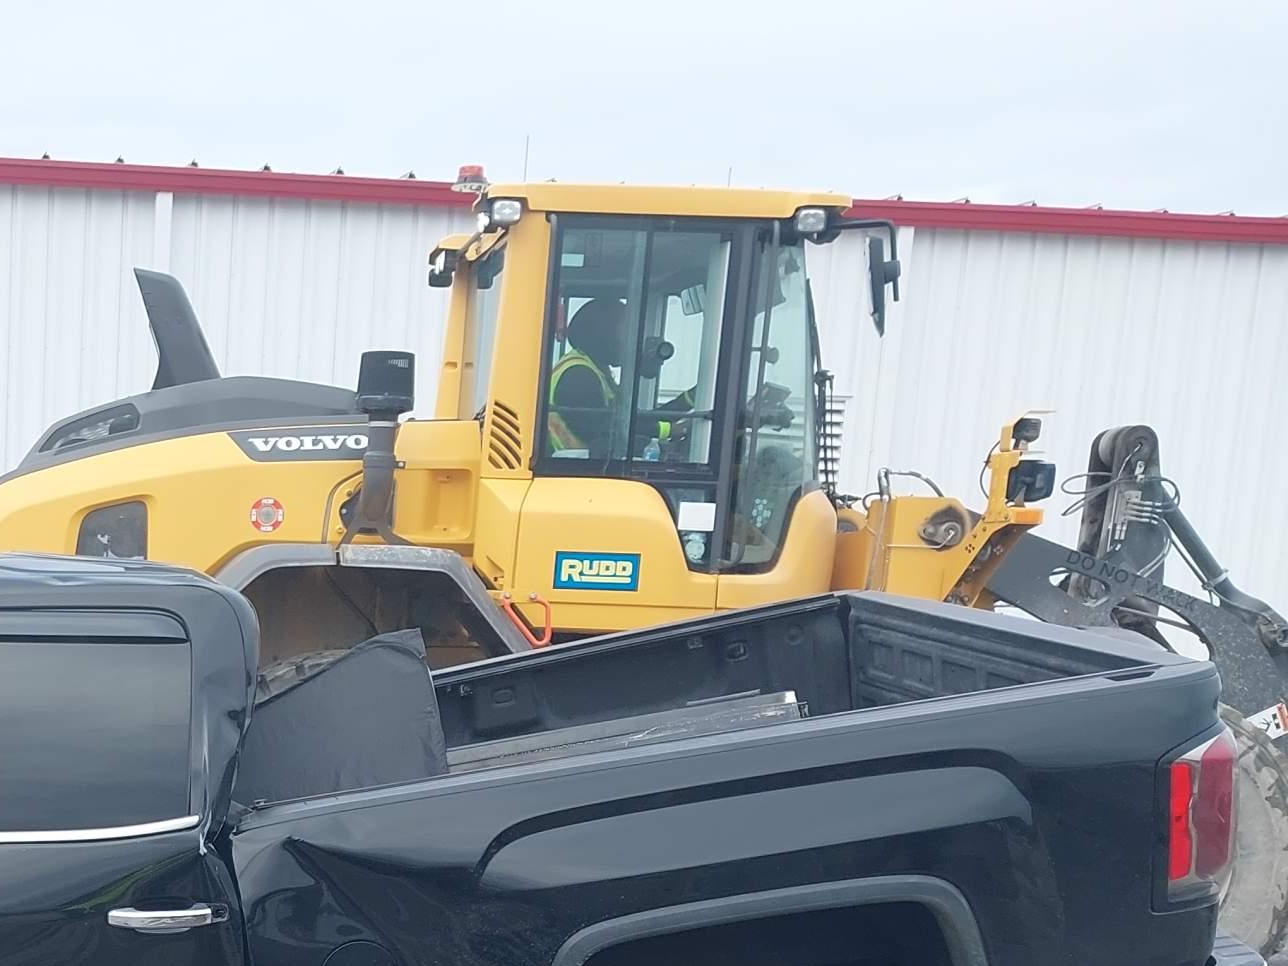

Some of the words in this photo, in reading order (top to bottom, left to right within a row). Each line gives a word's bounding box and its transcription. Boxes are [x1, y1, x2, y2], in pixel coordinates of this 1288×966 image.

[247, 434, 369, 452] VOLVO
[560, 558, 633, 583] RUDD
[1066, 550, 1096, 571] DO
[1099, 562, 1142, 588] NOT
